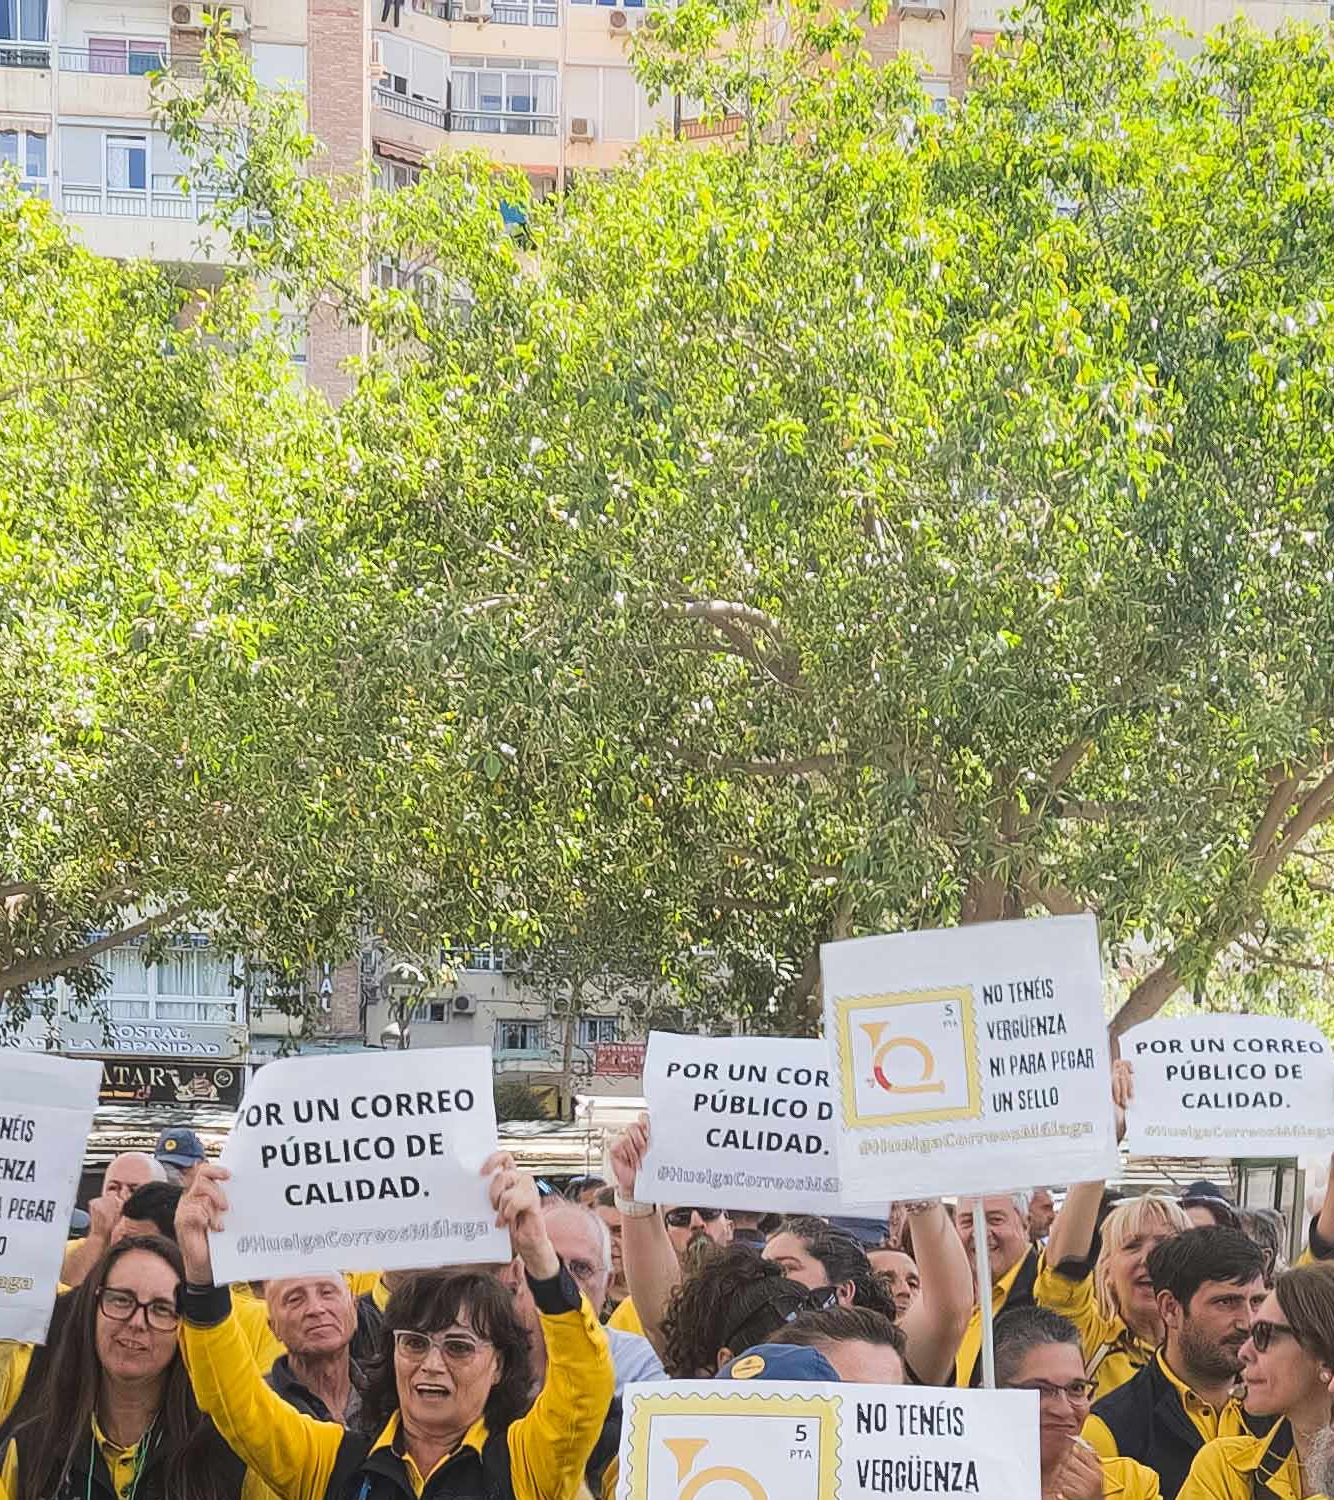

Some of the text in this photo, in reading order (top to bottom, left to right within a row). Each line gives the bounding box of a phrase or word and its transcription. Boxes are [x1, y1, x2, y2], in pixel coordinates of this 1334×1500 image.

[983, 977, 1054, 1006] NO TENÉIS
[987, 1013, 1067, 1042] VERGÜENZA
[1135, 1038, 1324, 1055] POR UN CORREO
[666, 1062, 830, 1087] POR UN COR
[990, 1048, 1095, 1078] NI PARA PEGAR
[1166, 1060, 1303, 1081] PÚBLICO DE
[293, 1098, 339, 1123] UN
[351, 1089, 475, 1120] CORREO
[693, 1089, 808, 1119] PÚBLICO
[993, 1086, 1059, 1113] UN SELLO
[1181, 1091, 1291, 1108] CALIDAD.
[261, 1133, 444, 1168] PÚBLICO DE
[706, 1128, 830, 1156] CALIDAD.
[285, 1175, 430, 1206] CALIDAD.
[8, 1198, 56, 1223] PEGAR
[237, 1218, 489, 1254] #HuelgaCorreosMálaga
[795, 1424, 807, 1443] 5
[856, 1401, 965, 1437] NO TENÉIS
[789, 1449, 813, 1460] PTA
[856, 1455, 980, 1494] VERGÜENZA
